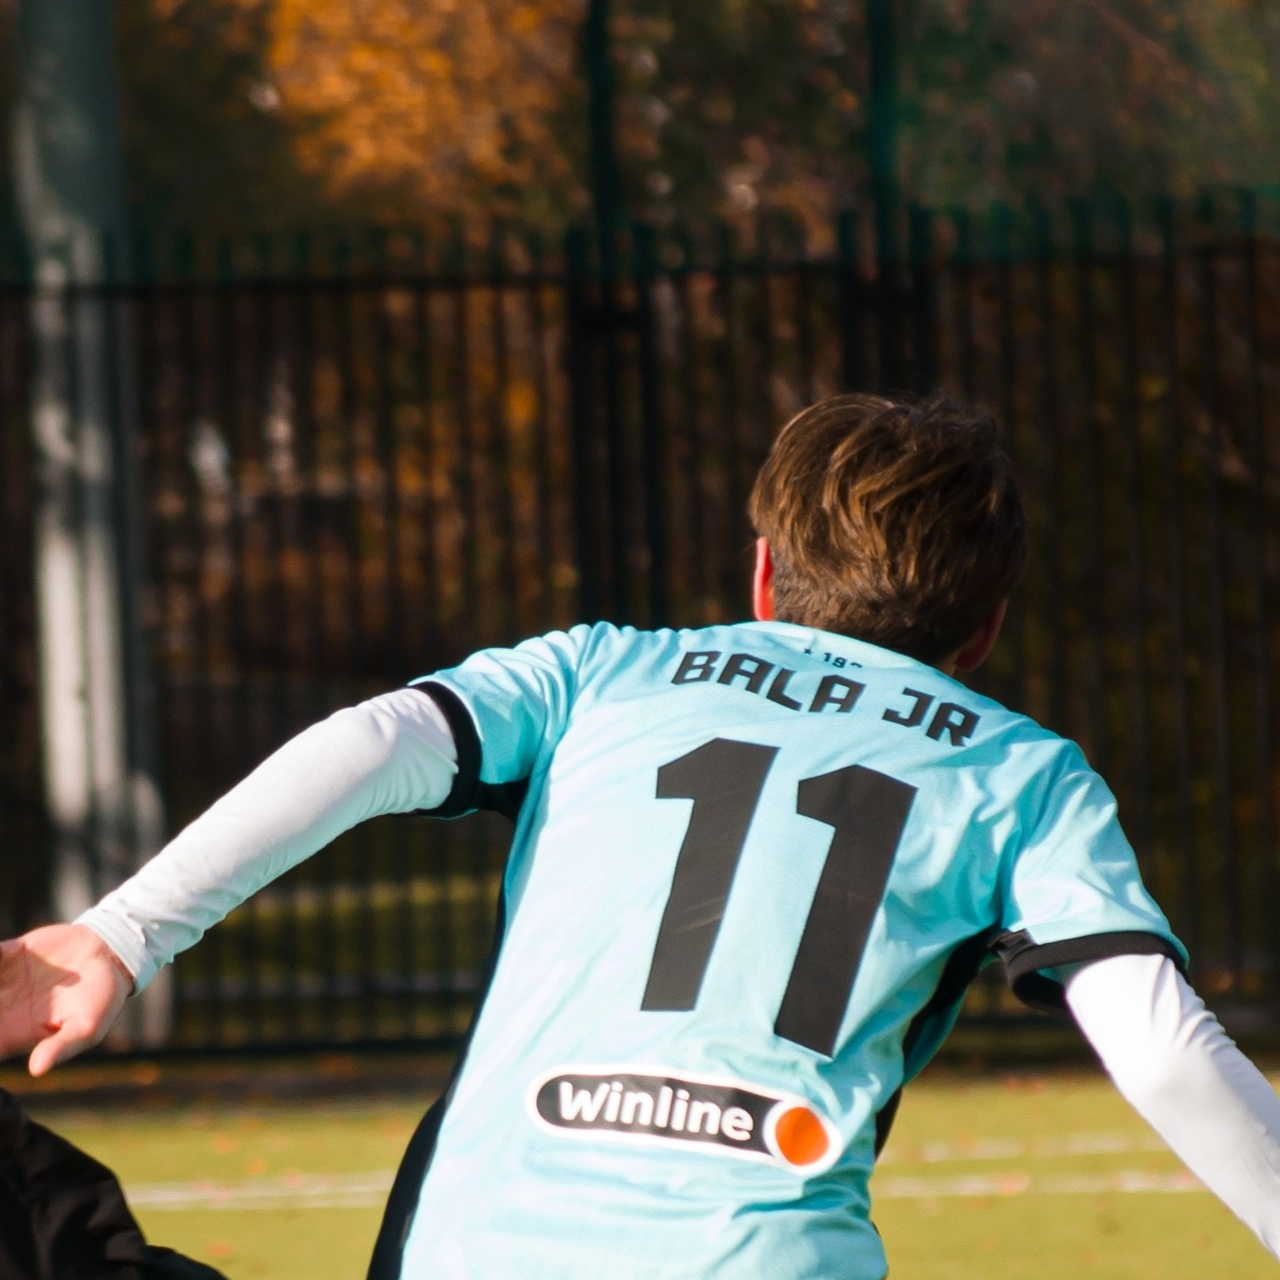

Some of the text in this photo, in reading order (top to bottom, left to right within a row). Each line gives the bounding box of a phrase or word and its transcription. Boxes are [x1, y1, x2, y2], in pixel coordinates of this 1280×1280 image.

[671, 650, 981, 747] BALA JR
[640, 737, 919, 1060] 11
